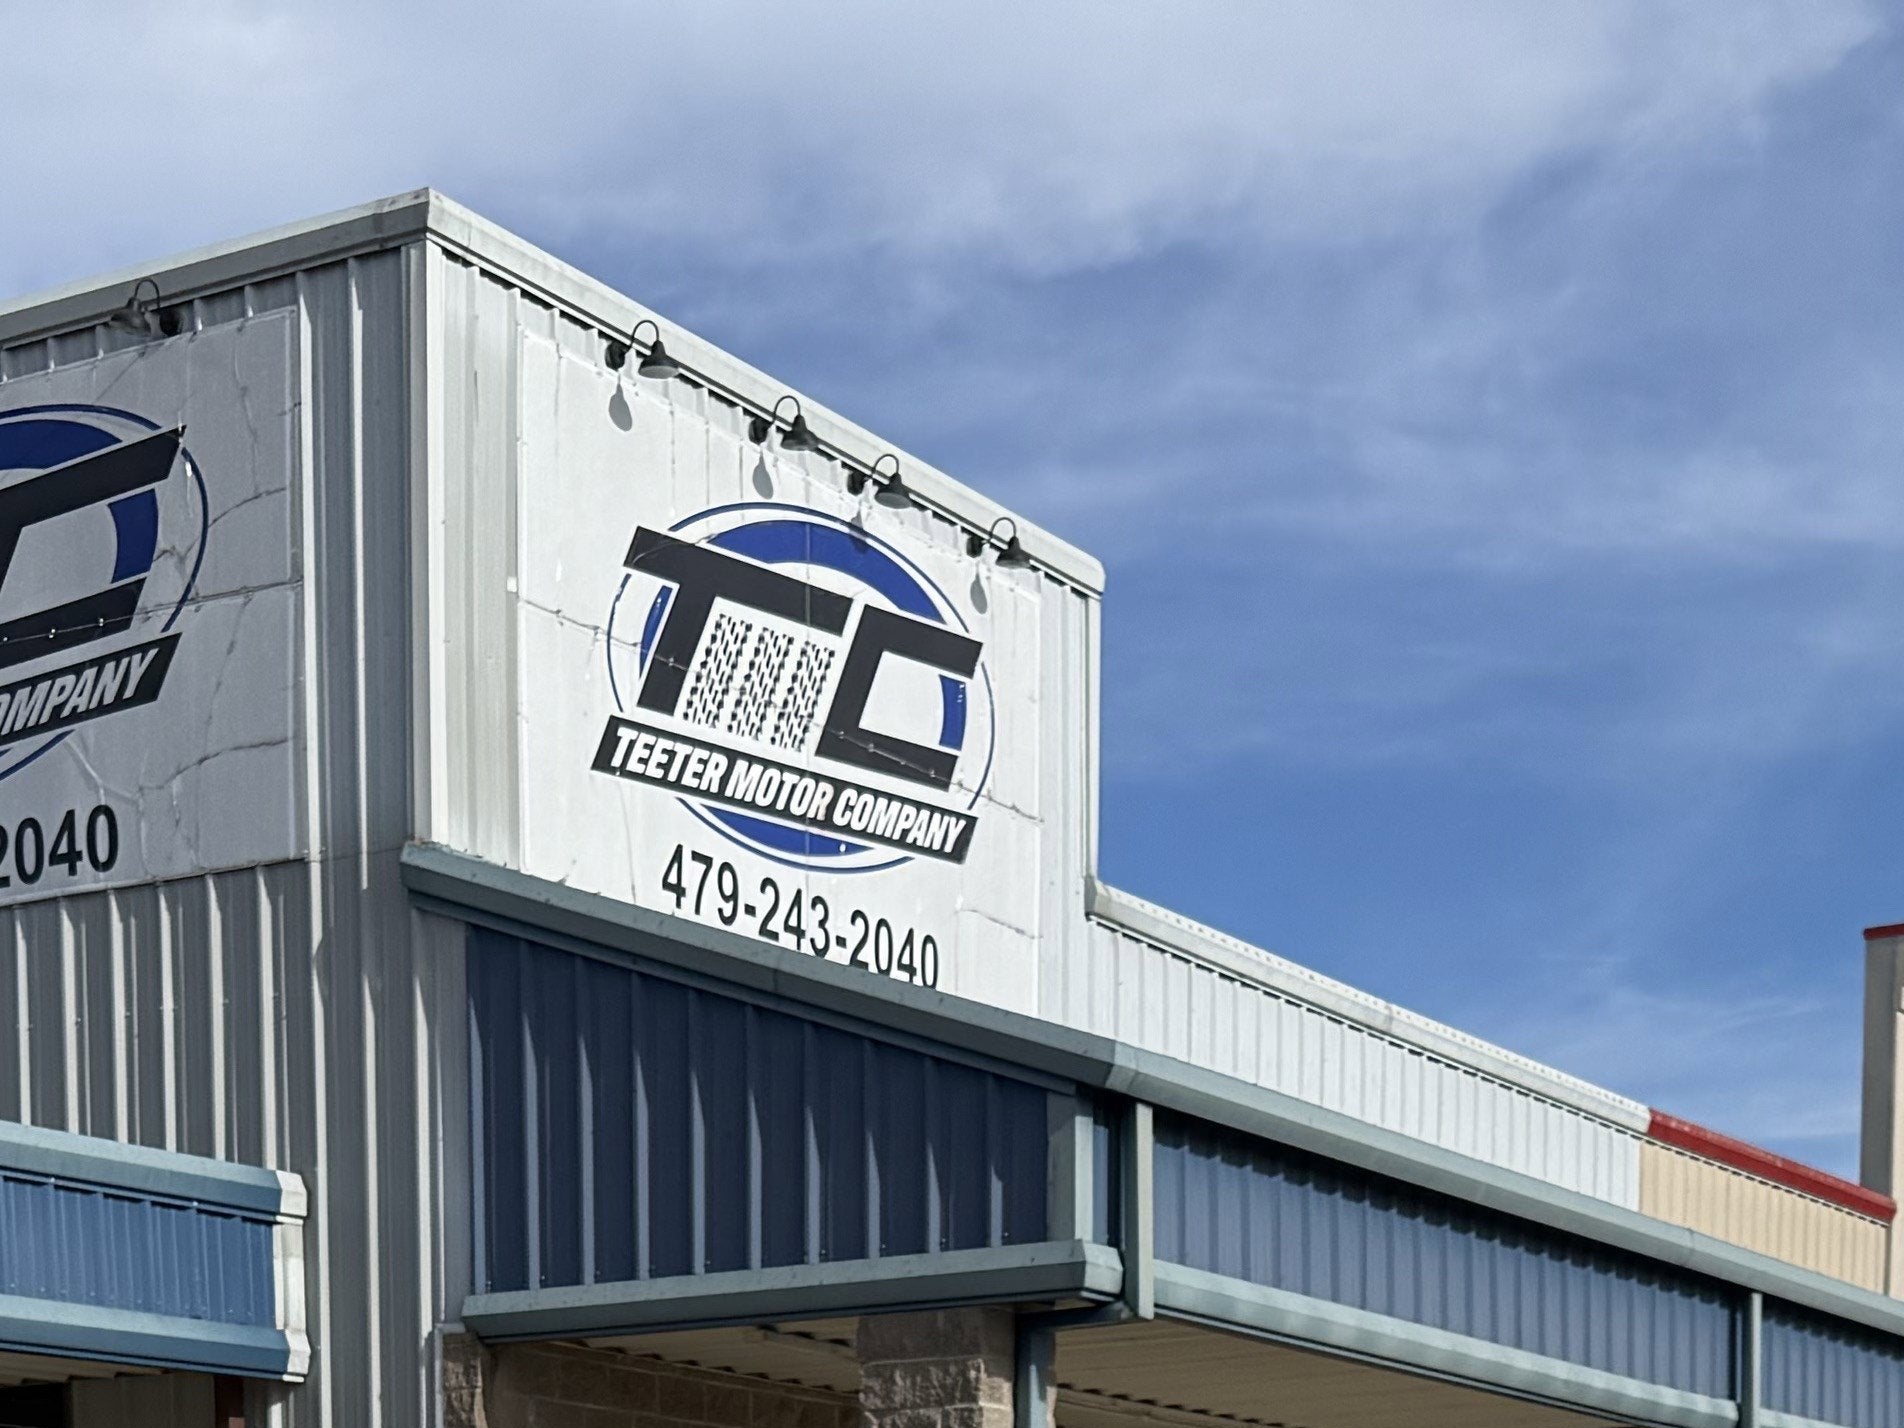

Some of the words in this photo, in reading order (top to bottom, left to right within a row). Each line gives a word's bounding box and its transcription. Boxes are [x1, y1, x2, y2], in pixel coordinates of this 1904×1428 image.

[608, 727, 726, 792] TEETER
[726, 759, 833, 820] MOTOR
[833, 793, 966, 854] COMPANY
[661, 843, 940, 989] 479-243-2040
